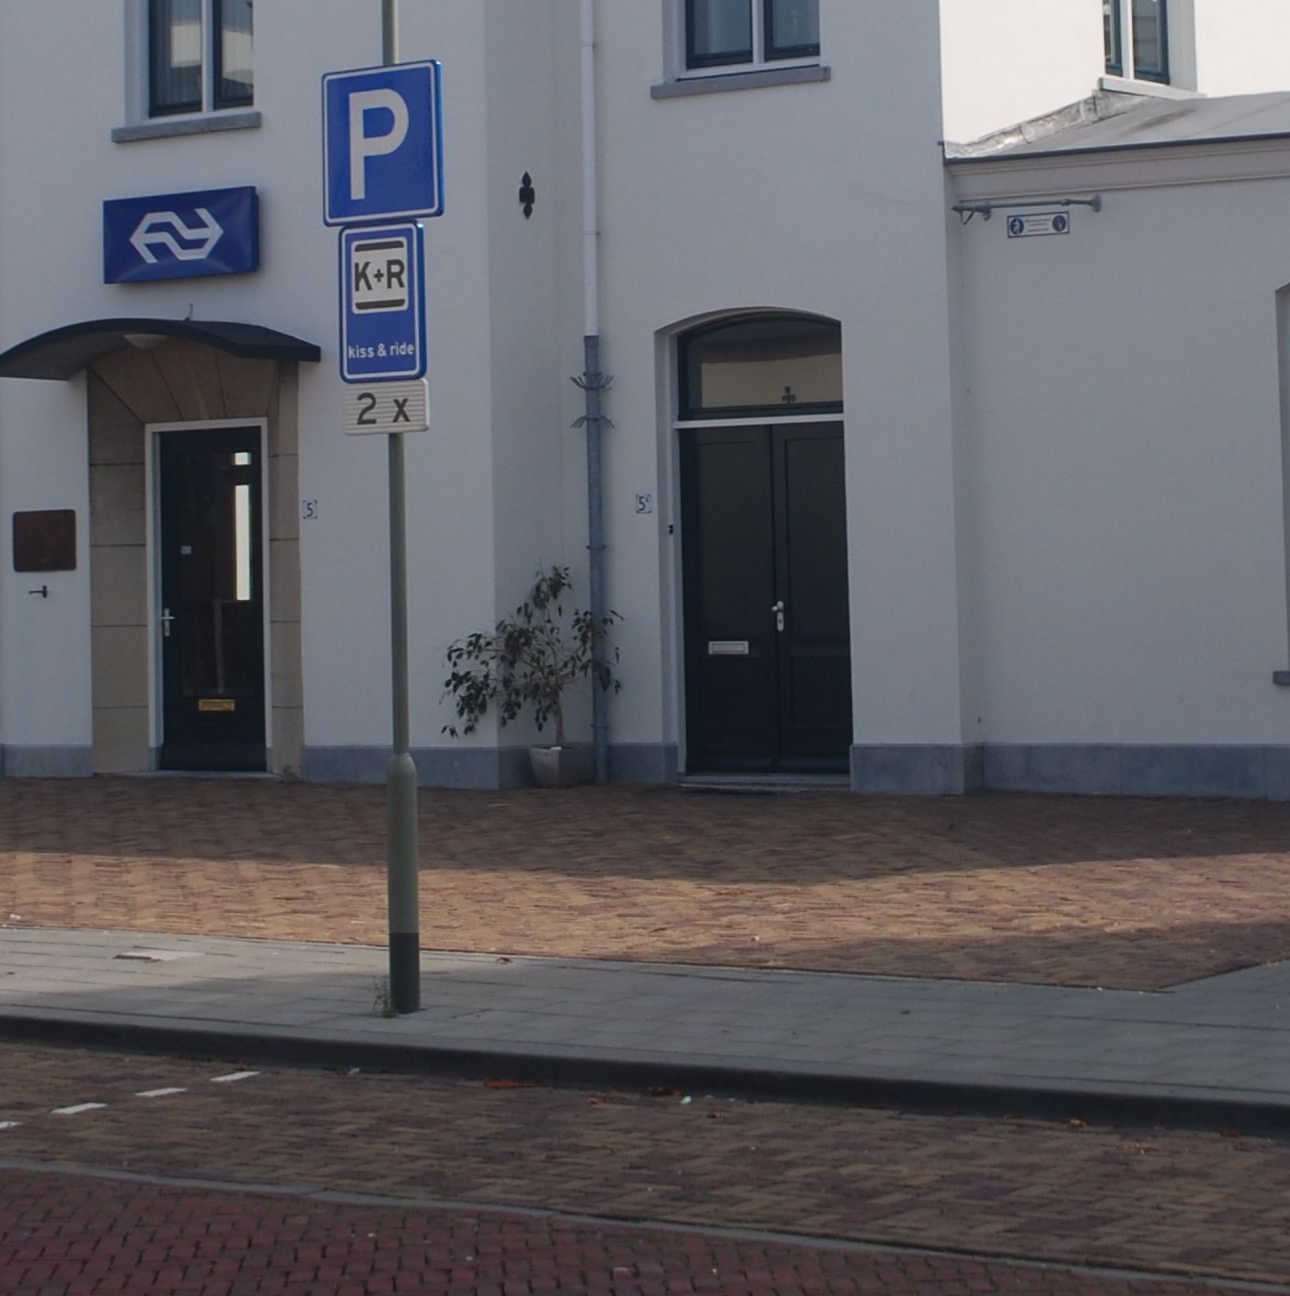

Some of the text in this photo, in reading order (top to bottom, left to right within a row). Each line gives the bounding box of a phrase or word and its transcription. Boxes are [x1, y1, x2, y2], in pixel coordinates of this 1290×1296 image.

[349, 88, 409, 200] P
[354, 259, 405, 292] K+R
[348, 341, 415, 359] kiss & ride
[356, 393, 377, 425] 2
